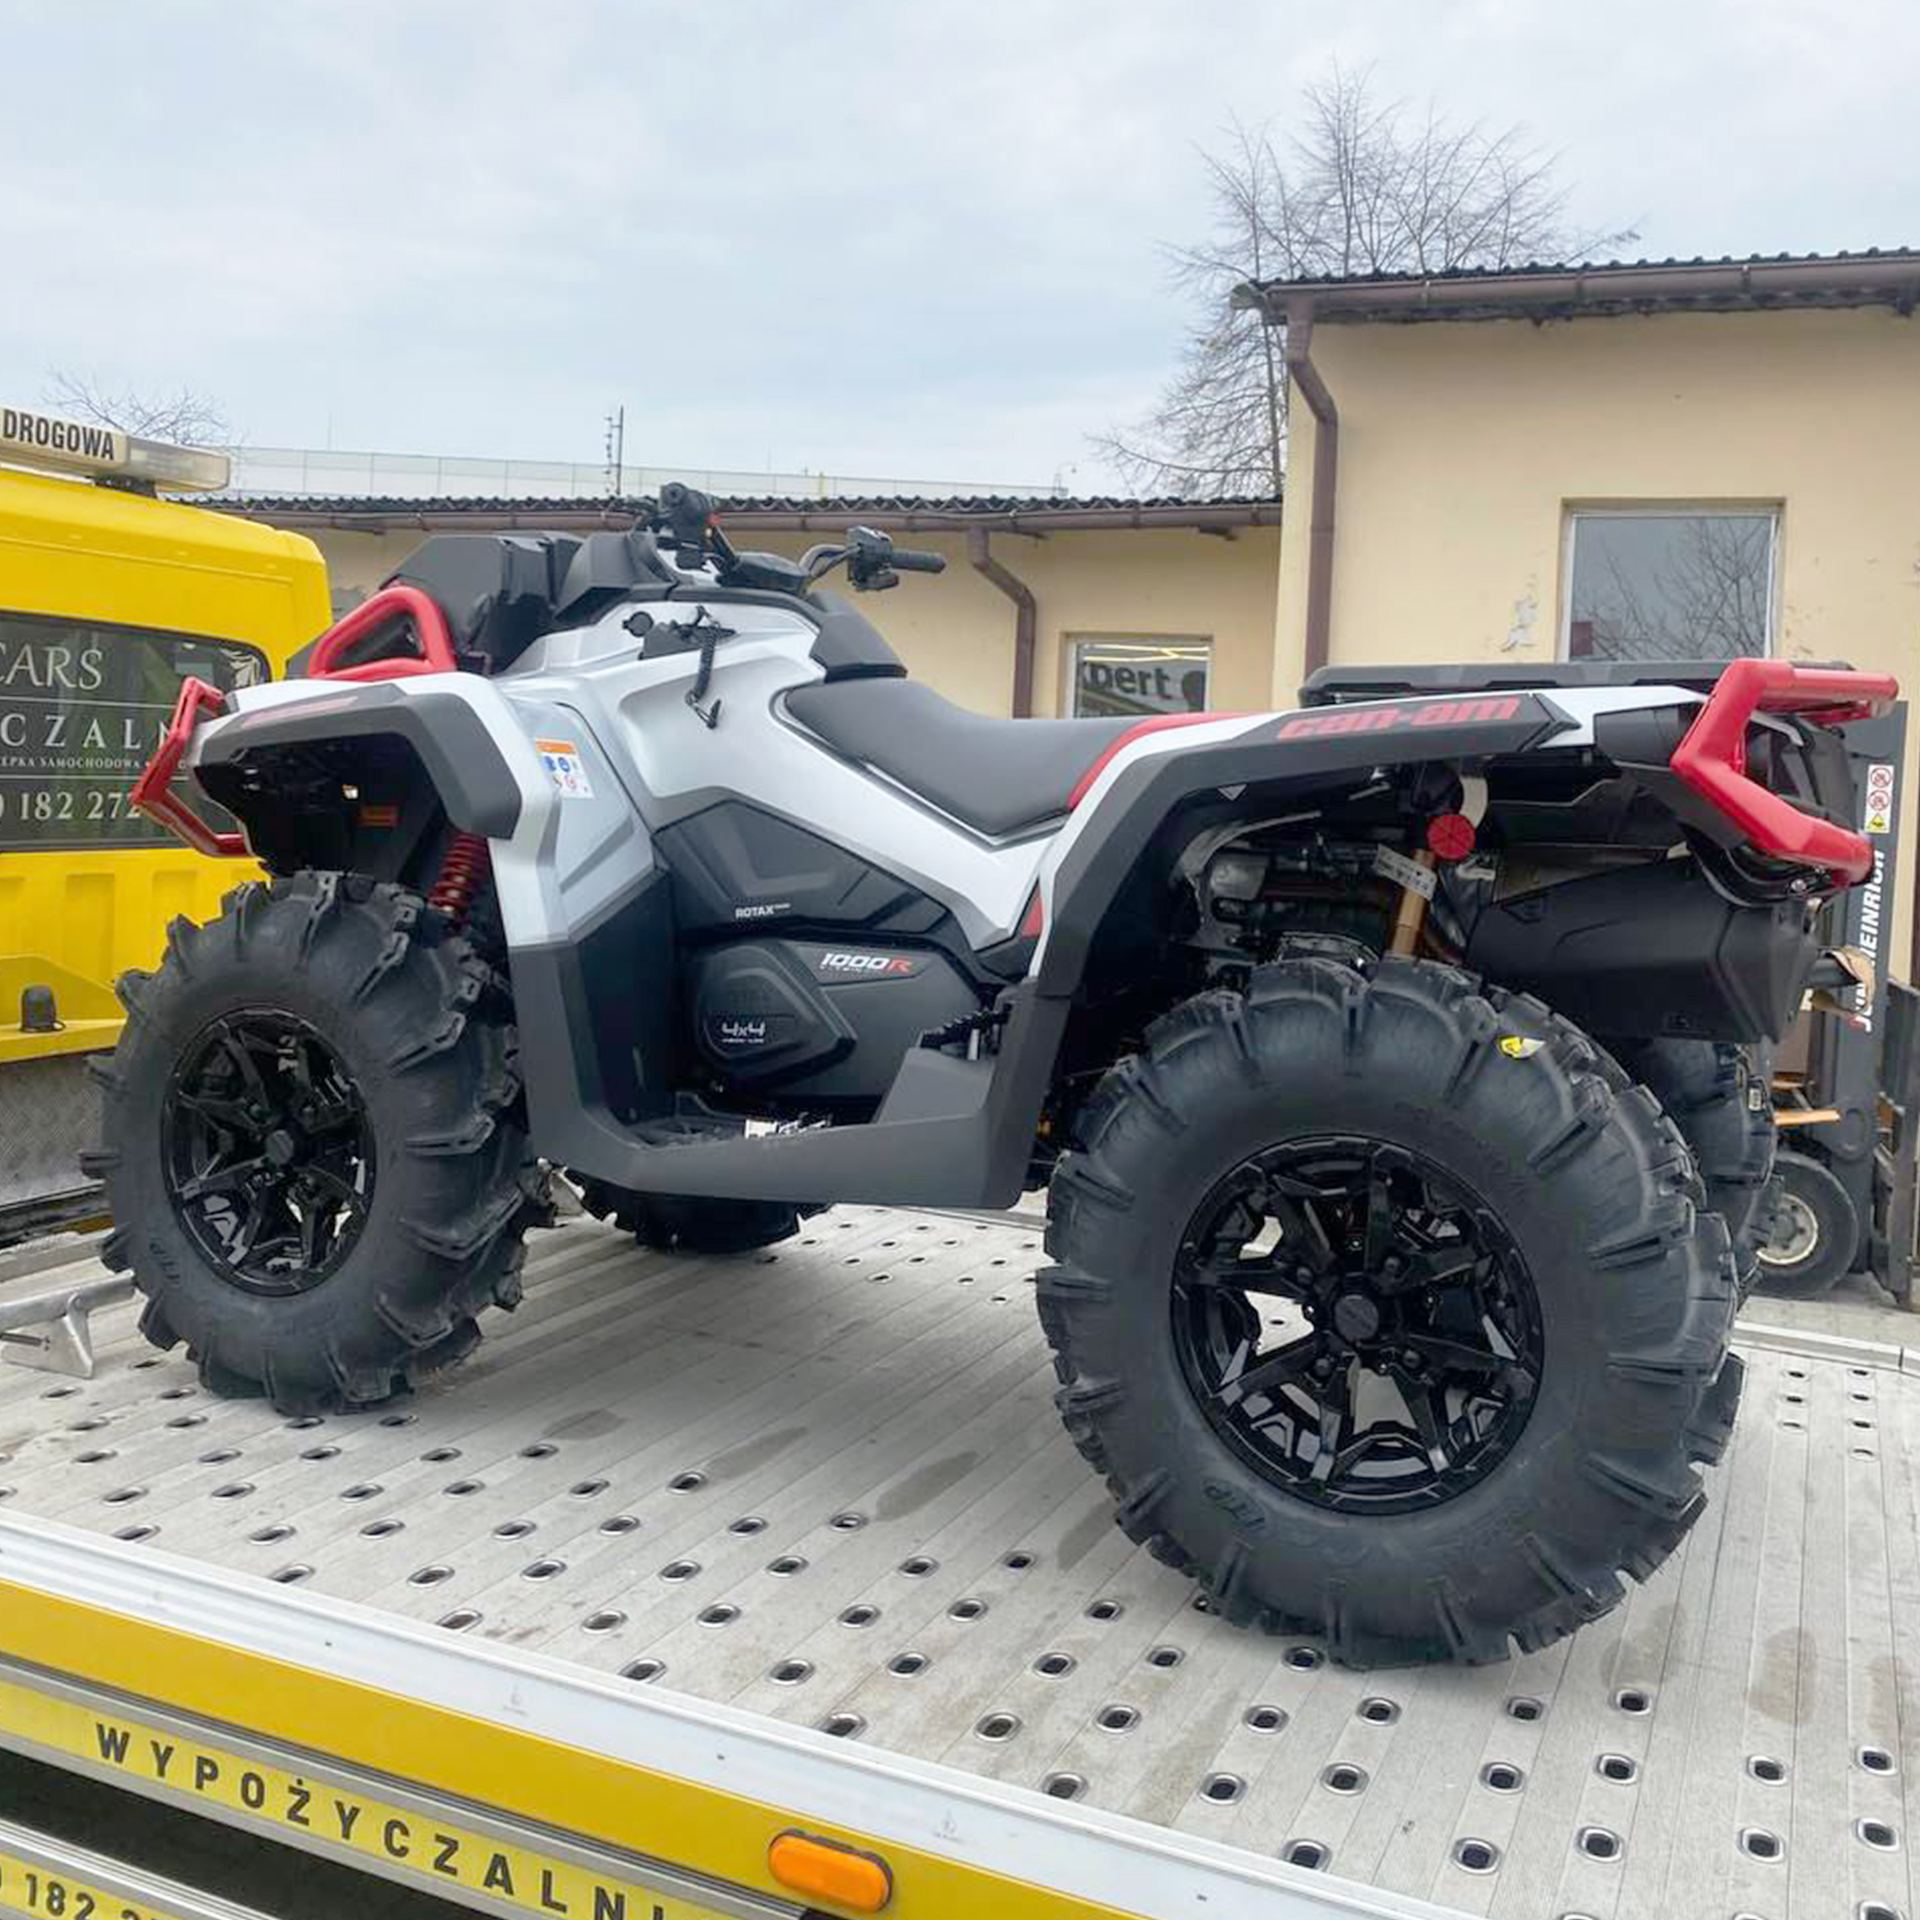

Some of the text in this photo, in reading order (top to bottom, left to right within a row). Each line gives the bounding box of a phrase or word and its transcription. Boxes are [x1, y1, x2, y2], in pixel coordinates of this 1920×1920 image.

[3, 408, 114, 461] DROGOWA
[1277, 698, 1521, 741] can-am
[19, 791, 73, 820] 182
[735, 905, 775, 919] ROTAX
[822, 952, 914, 972] 1000R
[721, 1021, 766, 1037] 4x4
[25, 1873, 95, 1920] 182
